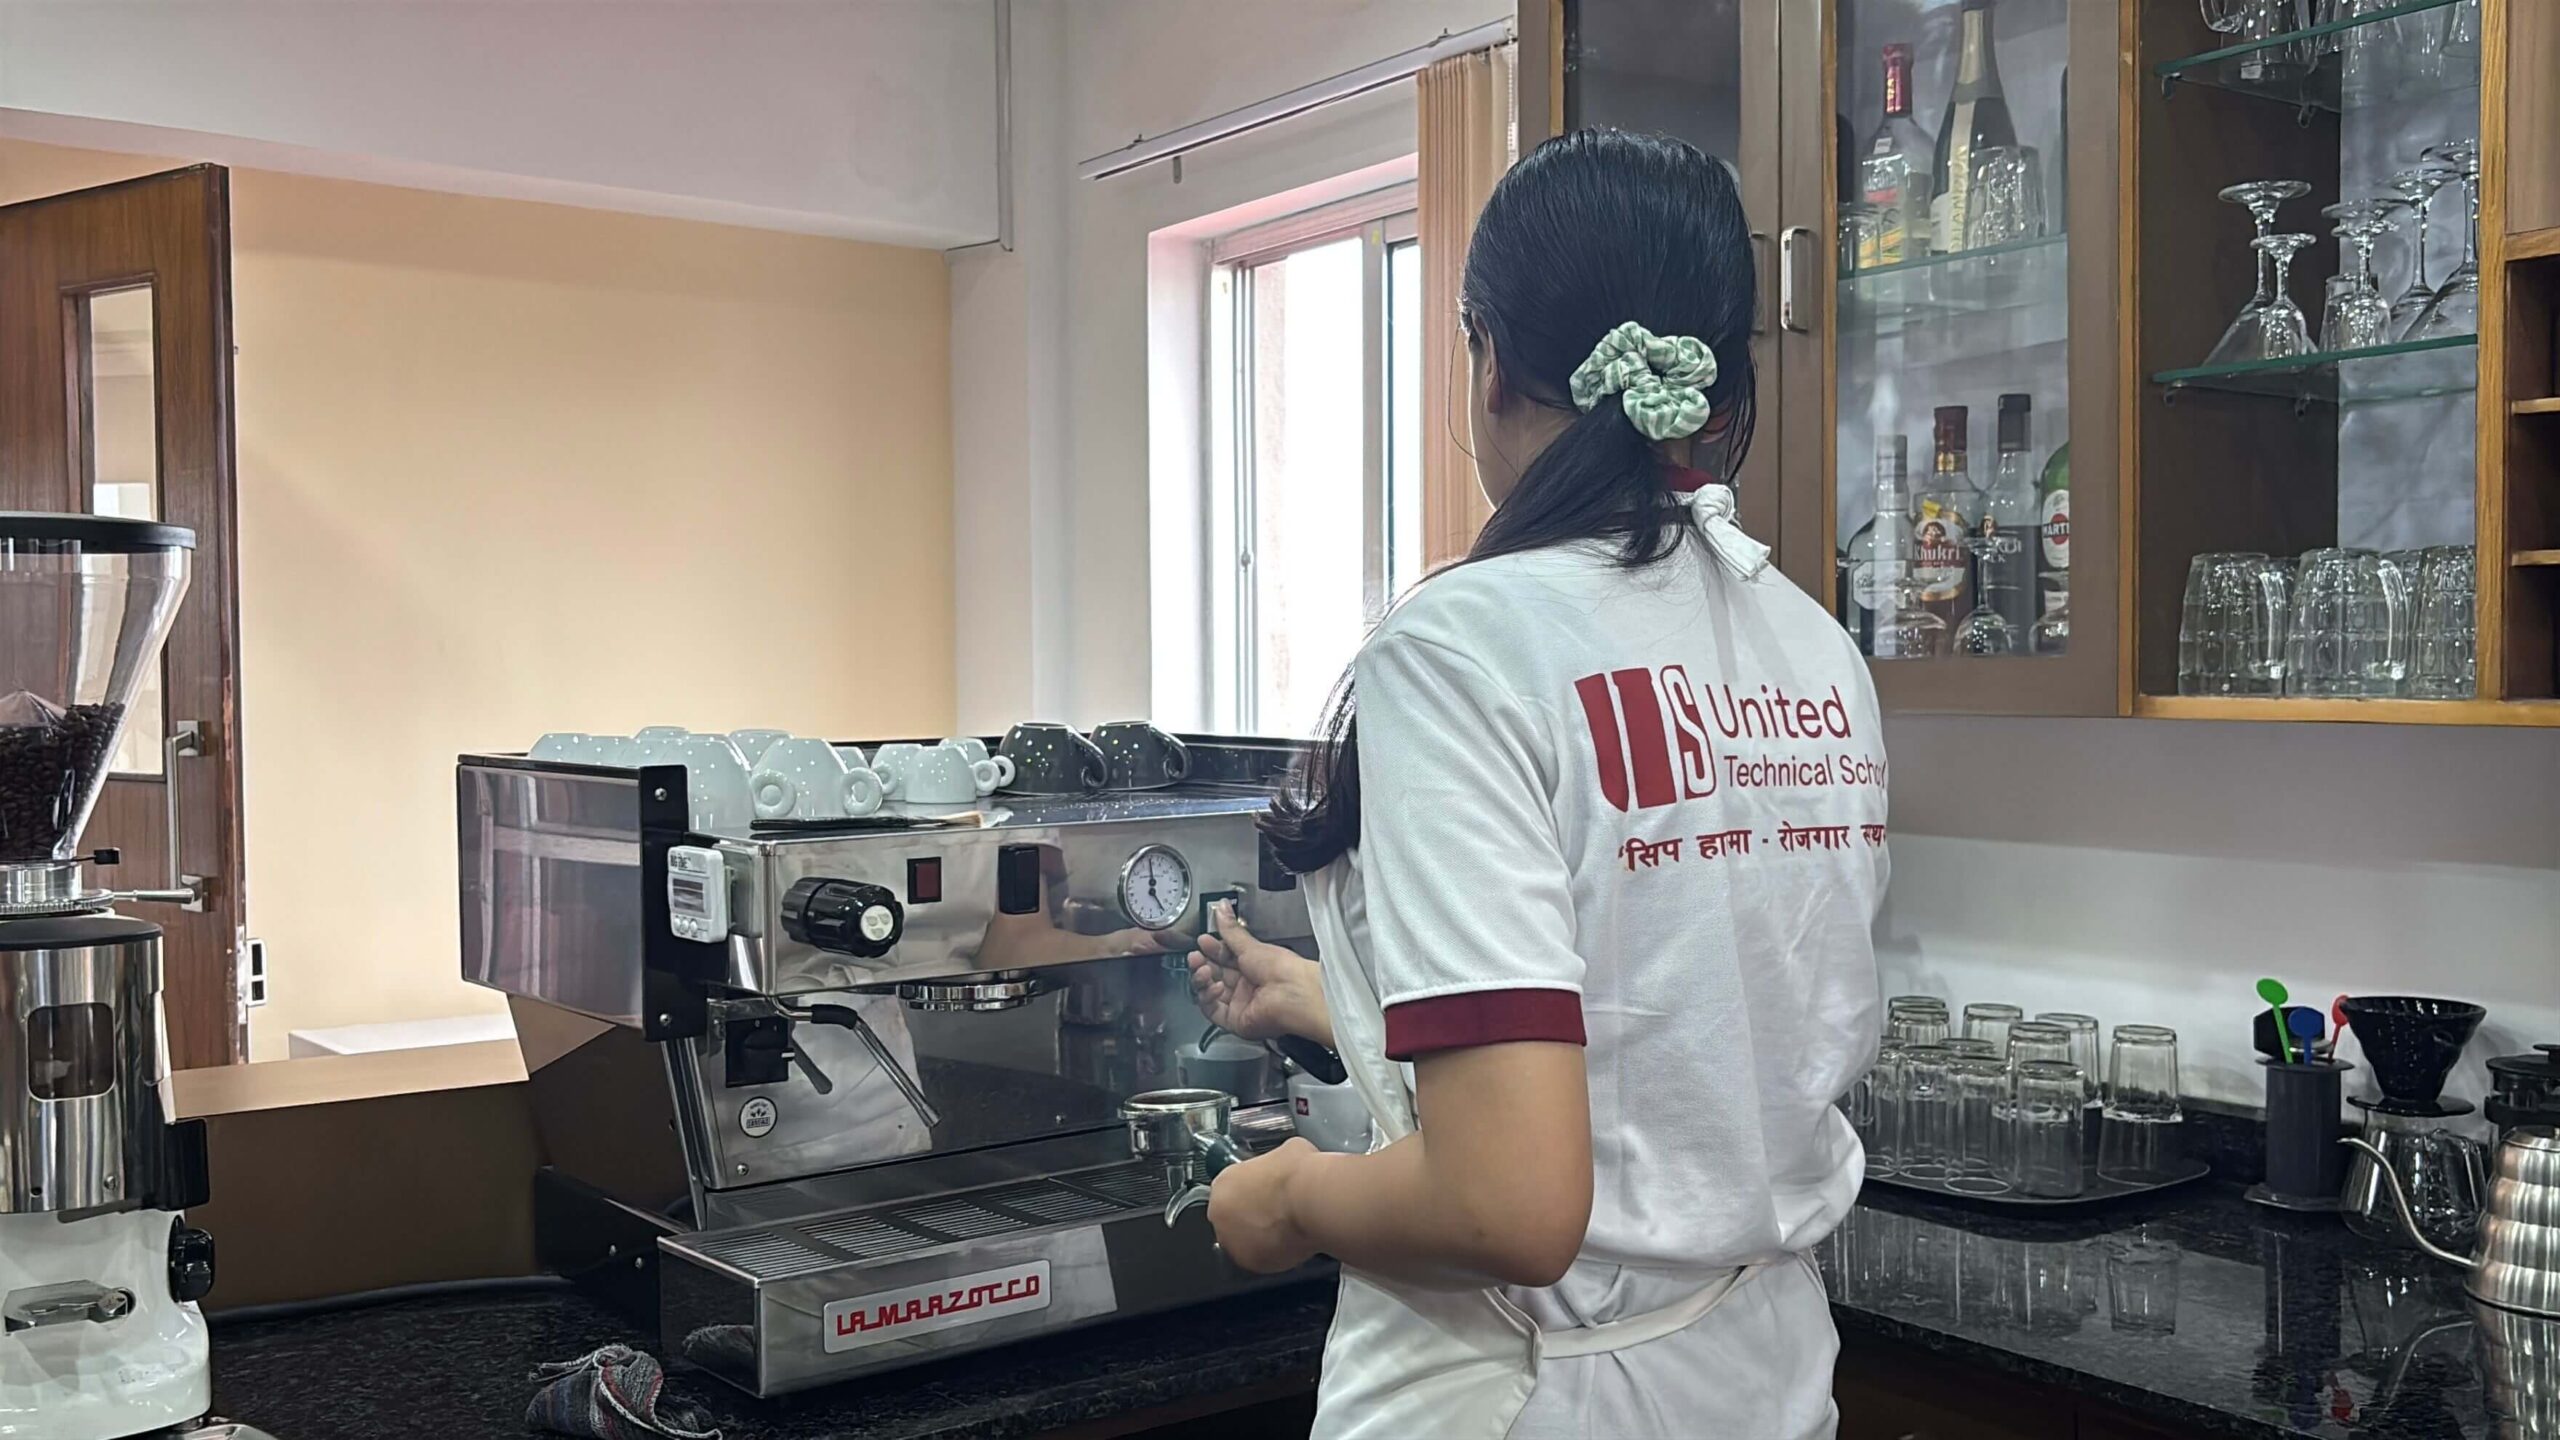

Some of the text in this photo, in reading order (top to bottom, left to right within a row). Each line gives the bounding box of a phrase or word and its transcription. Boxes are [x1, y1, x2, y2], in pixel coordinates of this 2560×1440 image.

[1914, 543, 1961, 560] Khukri
[1705, 684, 1852, 738] United
[1724, 754, 1835, 788] Technical
